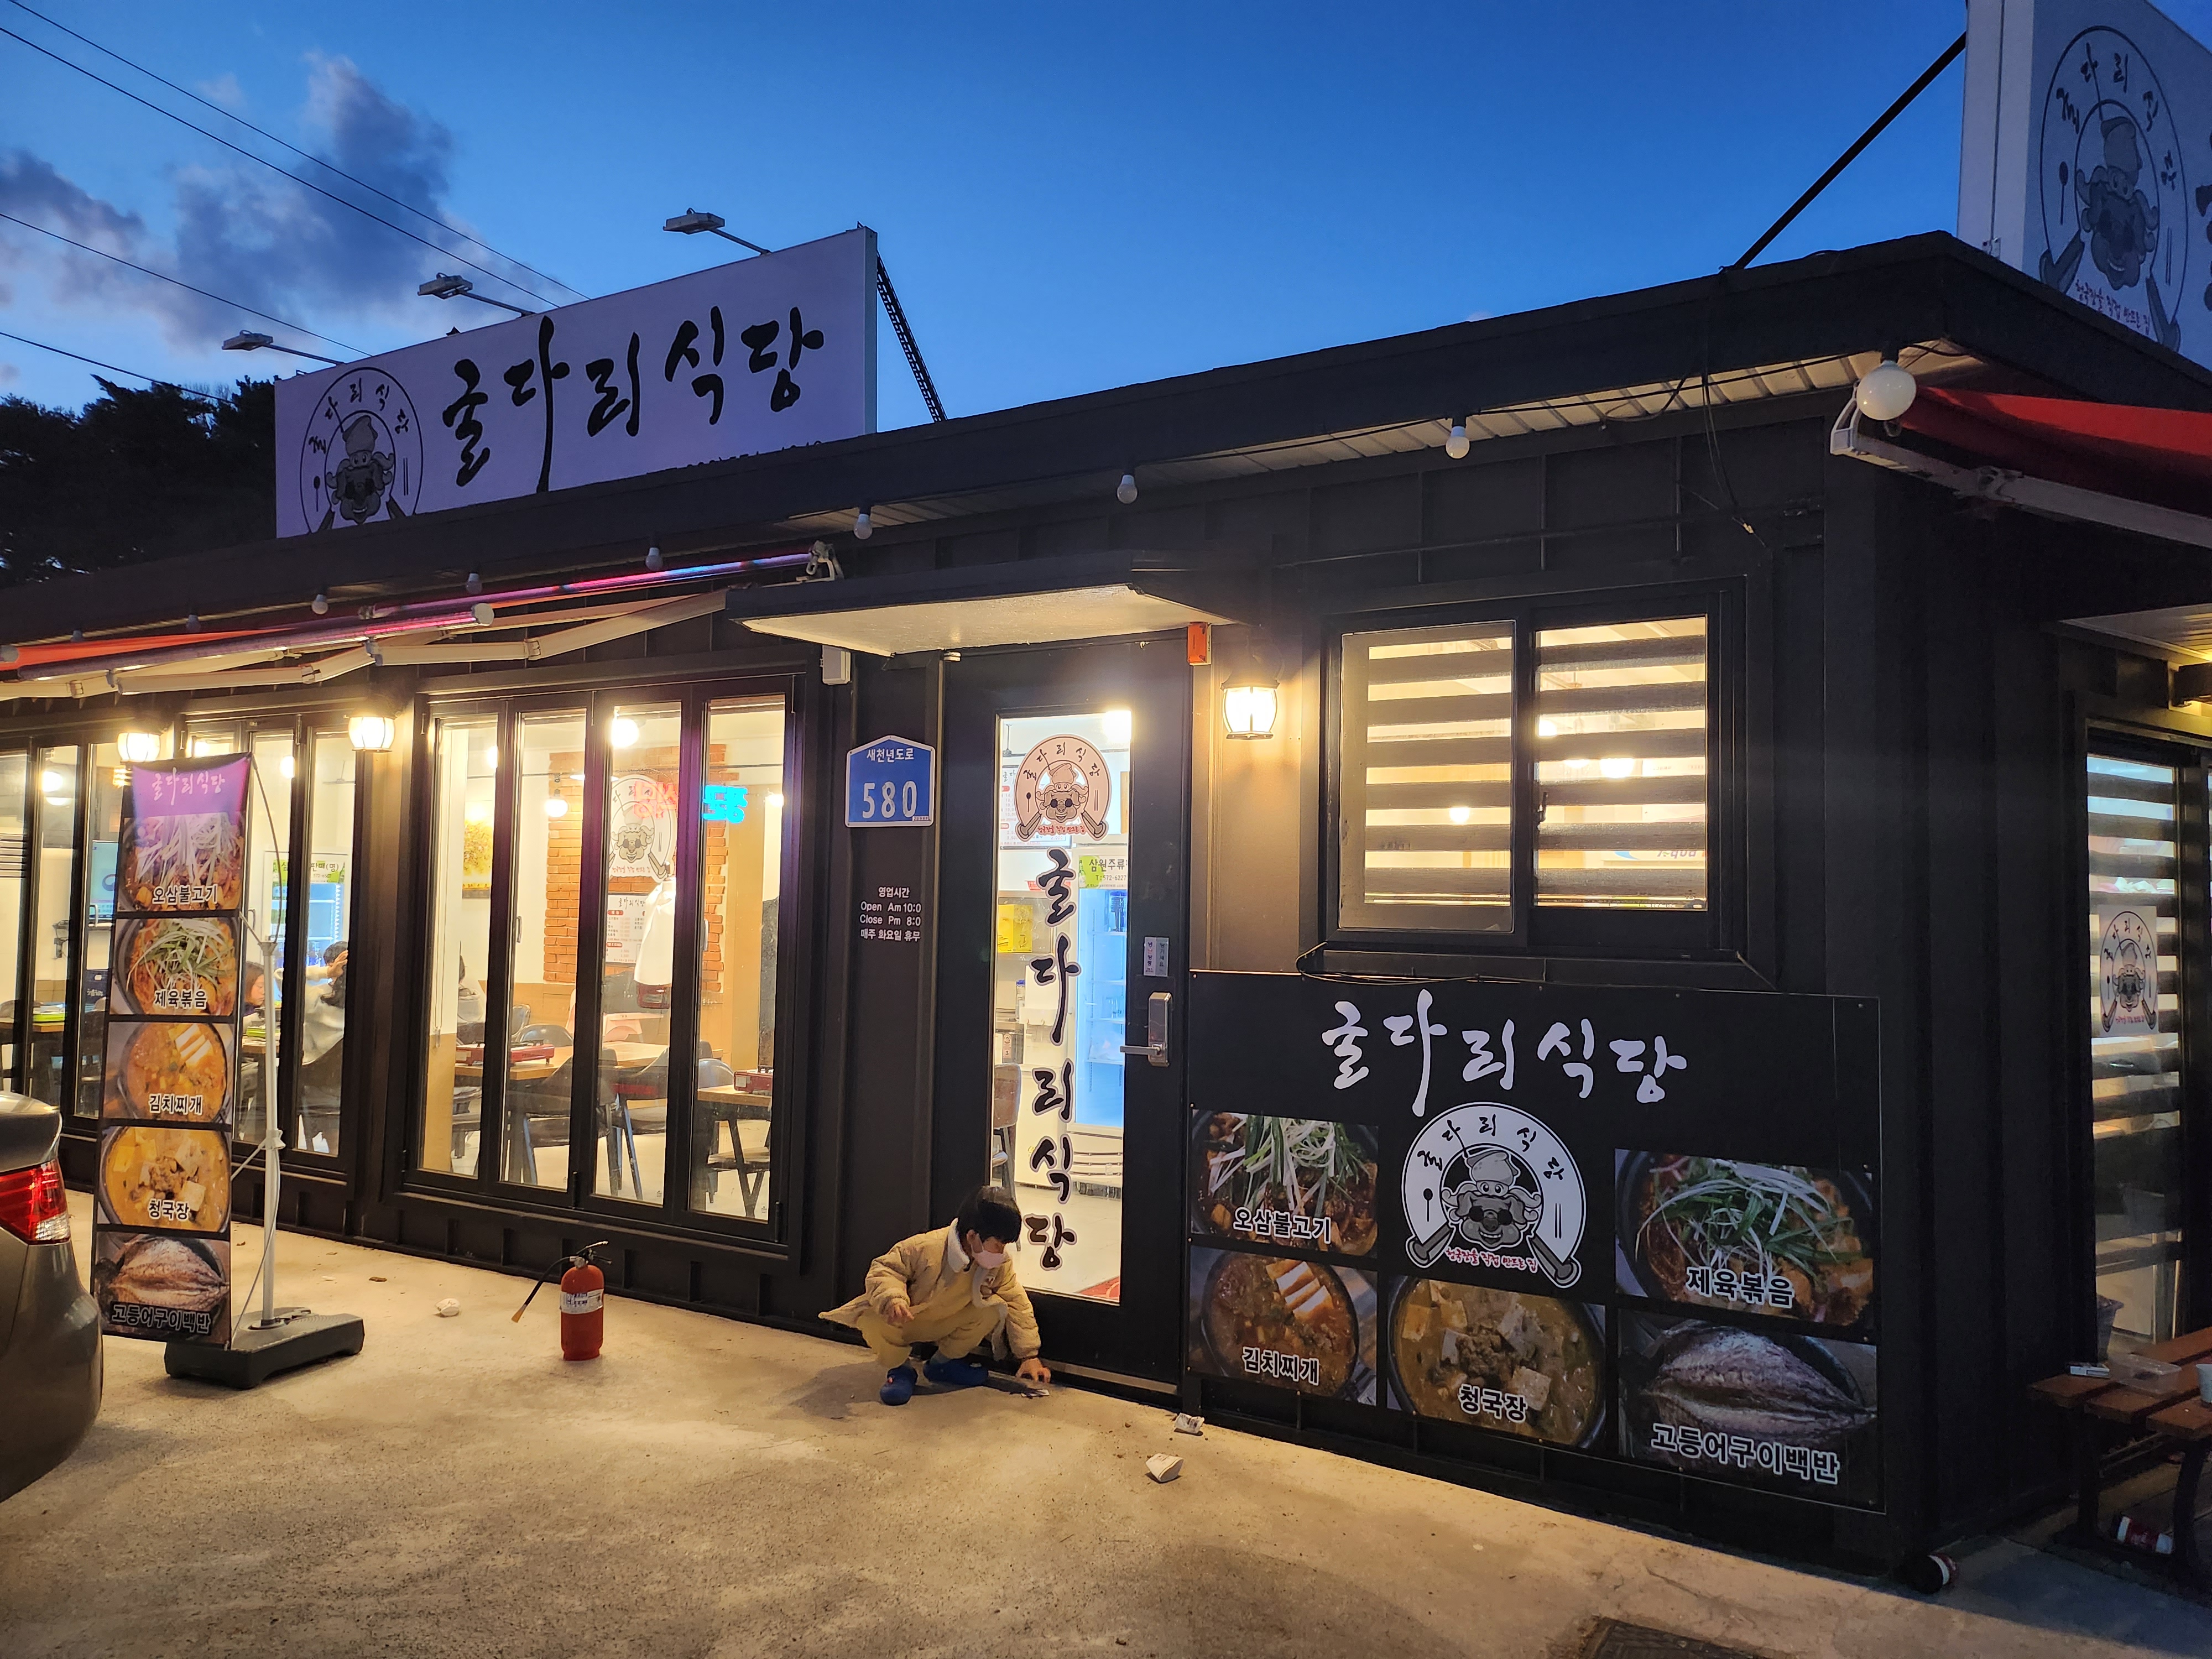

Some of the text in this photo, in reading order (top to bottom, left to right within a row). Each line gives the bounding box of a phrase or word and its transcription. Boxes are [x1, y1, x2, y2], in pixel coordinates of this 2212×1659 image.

[443, 306, 823, 492] 굴다리식당
[867, 748, 915, 762] 새천년도로
[152, 766, 226, 806] 굴다리식당
[862, 781, 917, 818] 580
[1088, 859, 1128, 872] 삼원주류
[152, 885, 218, 905] 오삼불고기
[860, 901, 882, 912] Open
[887, 902, 901, 912] Am
[878, 886, 910, 899] 영업시간
[859, 914, 883, 924] Close
[888, 915, 901, 925] Pm
[860, 928, 921, 942] 매주 화요일 휴무
[154, 989, 207, 1009] 제육볶음
[1025, 849, 1080, 1270] 굴다리식당
[1322, 988, 1687, 1117] 굴다리식당
[149, 1093, 203, 1115] 김치찌개
[1417, 1114, 1564, 1181] 굴다리식당
[148, 1199, 190, 1221] 청국장
[1233, 1206, 1332, 1245] 오삼불고기
[1446, 1248, 1537, 1271] 청국장을 직접 만드는 집
[1686, 1265, 1796, 1310] 제육볶음
[111, 1304, 211, 1334] 고등어구이백반
[1241, 1345, 1321, 1386] 김치찌개
[1457, 1384, 1528, 1422] 청국장
[1651, 1422, 1841, 1485] 고등어구이백반
